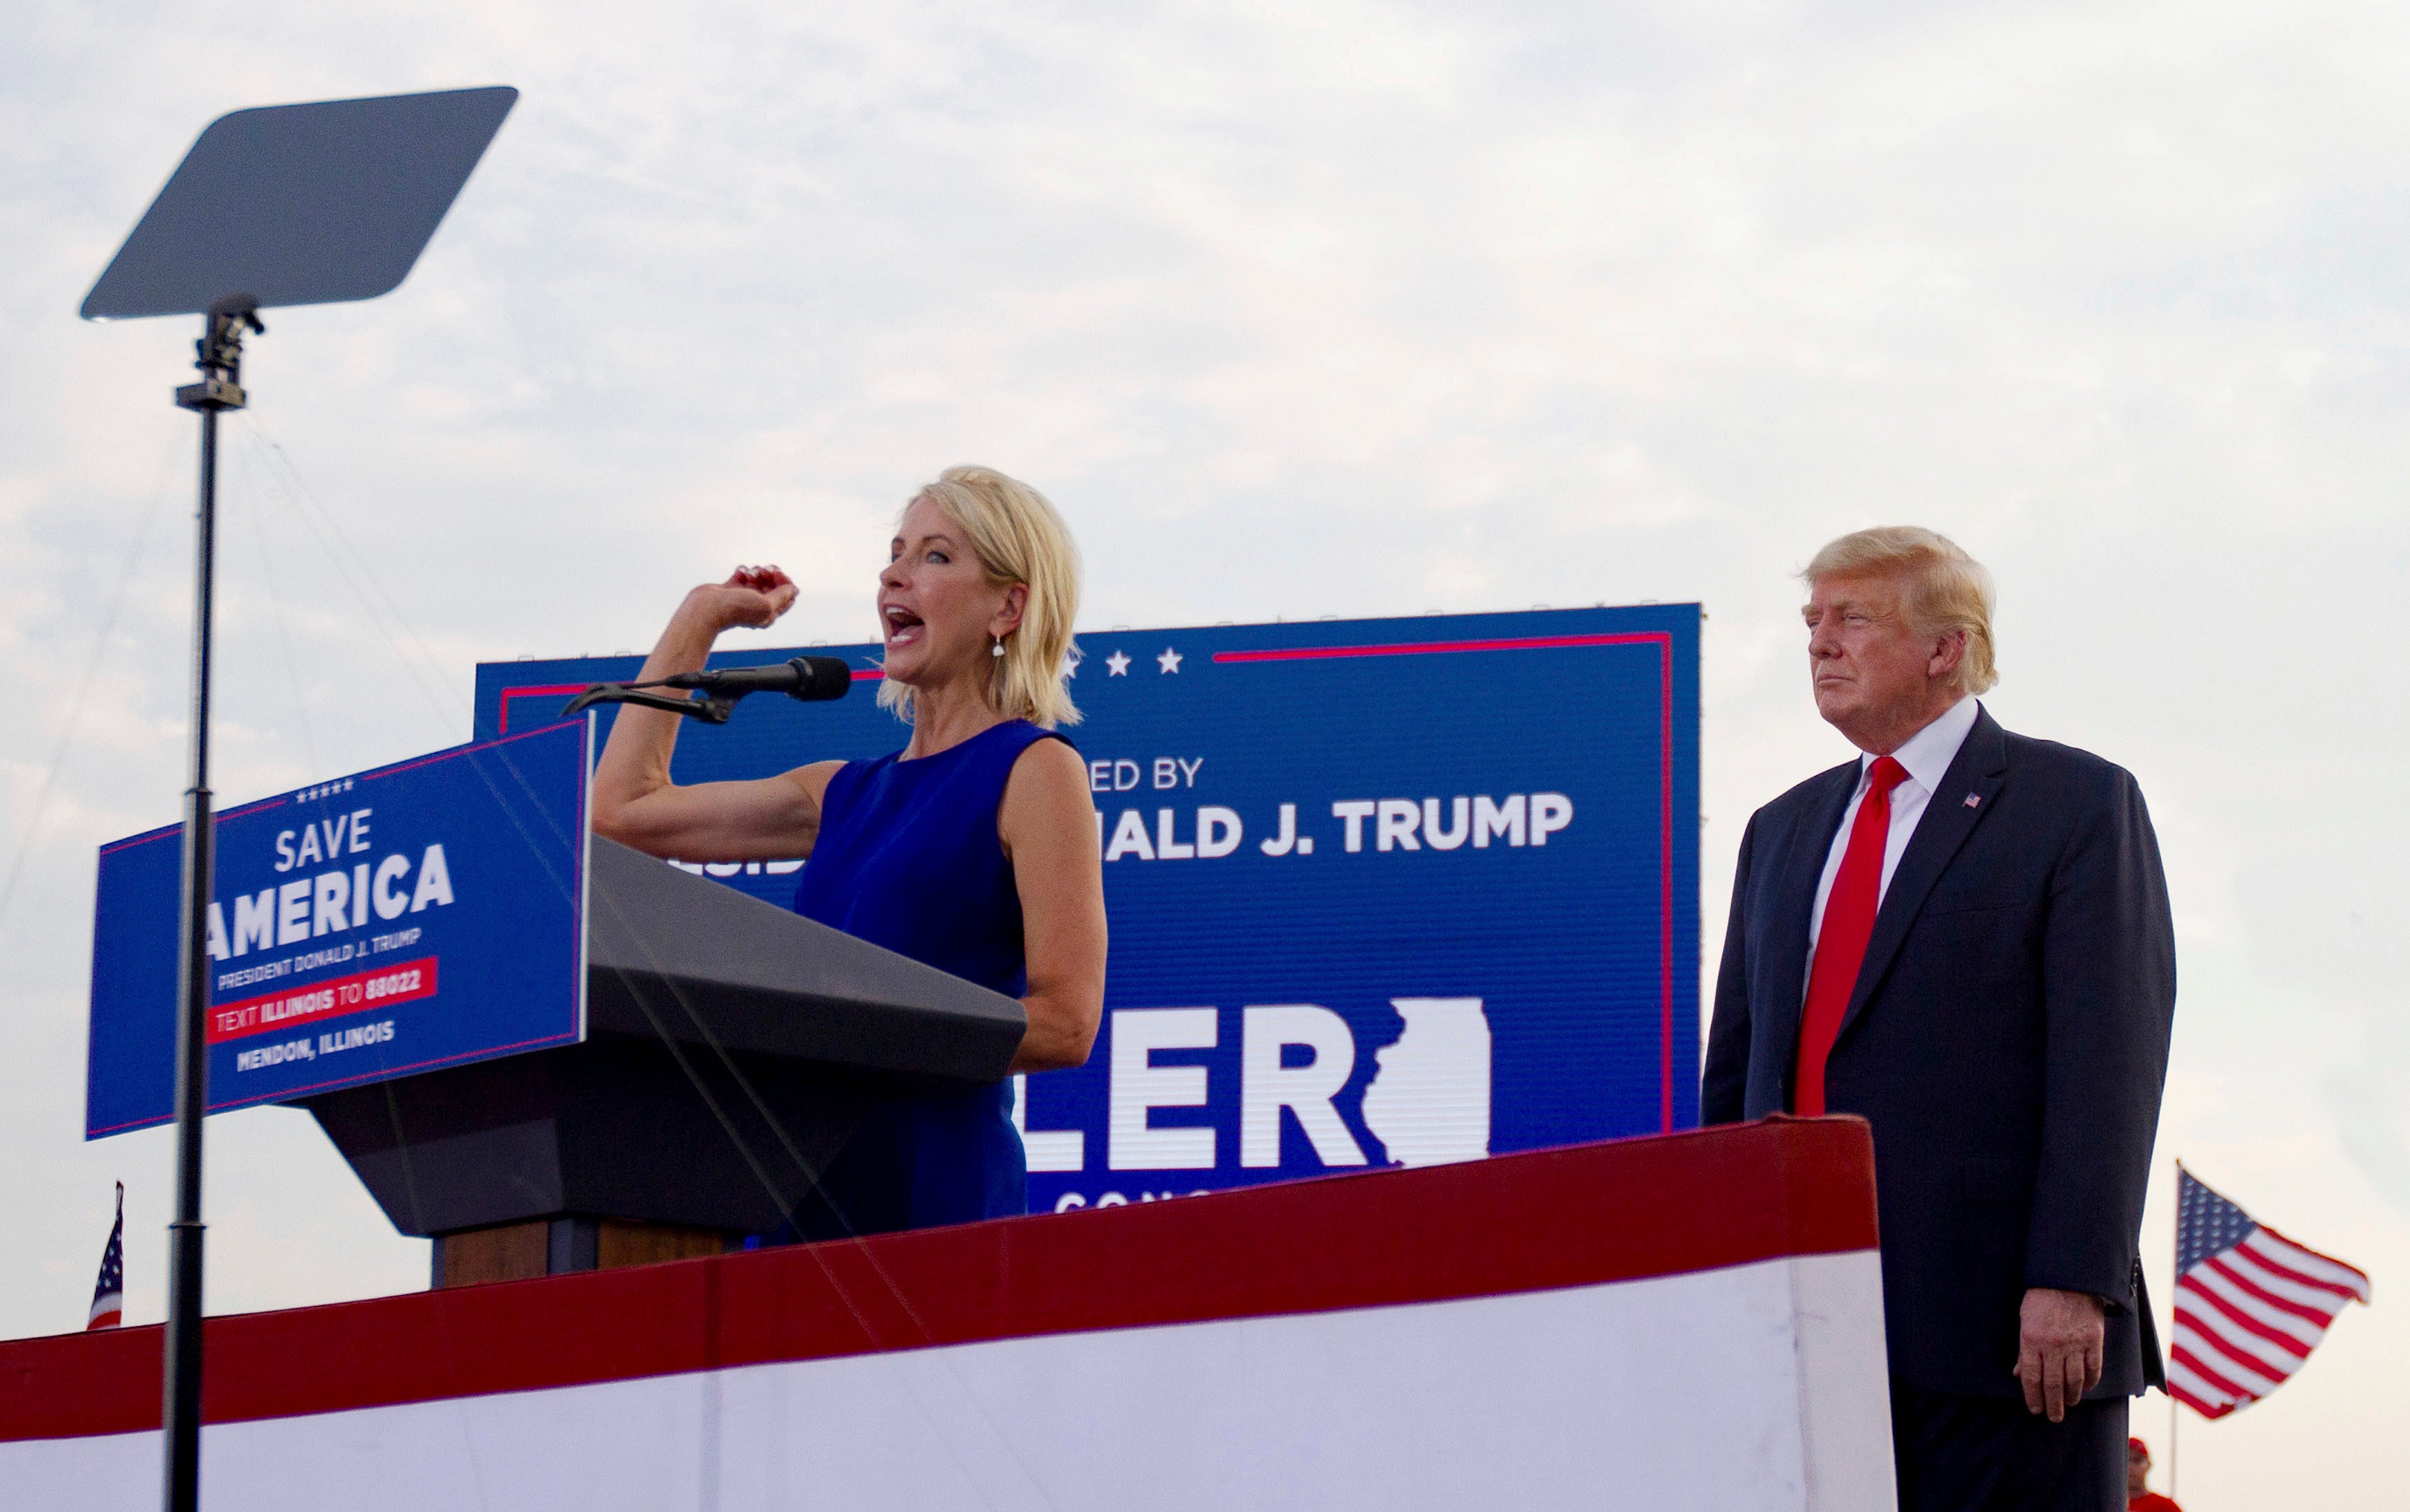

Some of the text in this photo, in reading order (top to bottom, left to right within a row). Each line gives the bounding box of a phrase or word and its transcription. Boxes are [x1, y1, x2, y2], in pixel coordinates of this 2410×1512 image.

[1090, 756, 1204, 792] ED BY
[274, 808, 373, 872] SAVE
[1095, 792, 1574, 862] ALD J. TRUMP
[206, 843, 454, 961] AMERICA
[218, 927, 422, 991] PRESIDENT DONALD J. TRUMP
[216, 969, 422, 1033] TEXT ILLINOIS TO 88022
[237, 1020, 395, 1072] MENDON, ILLINOIS
